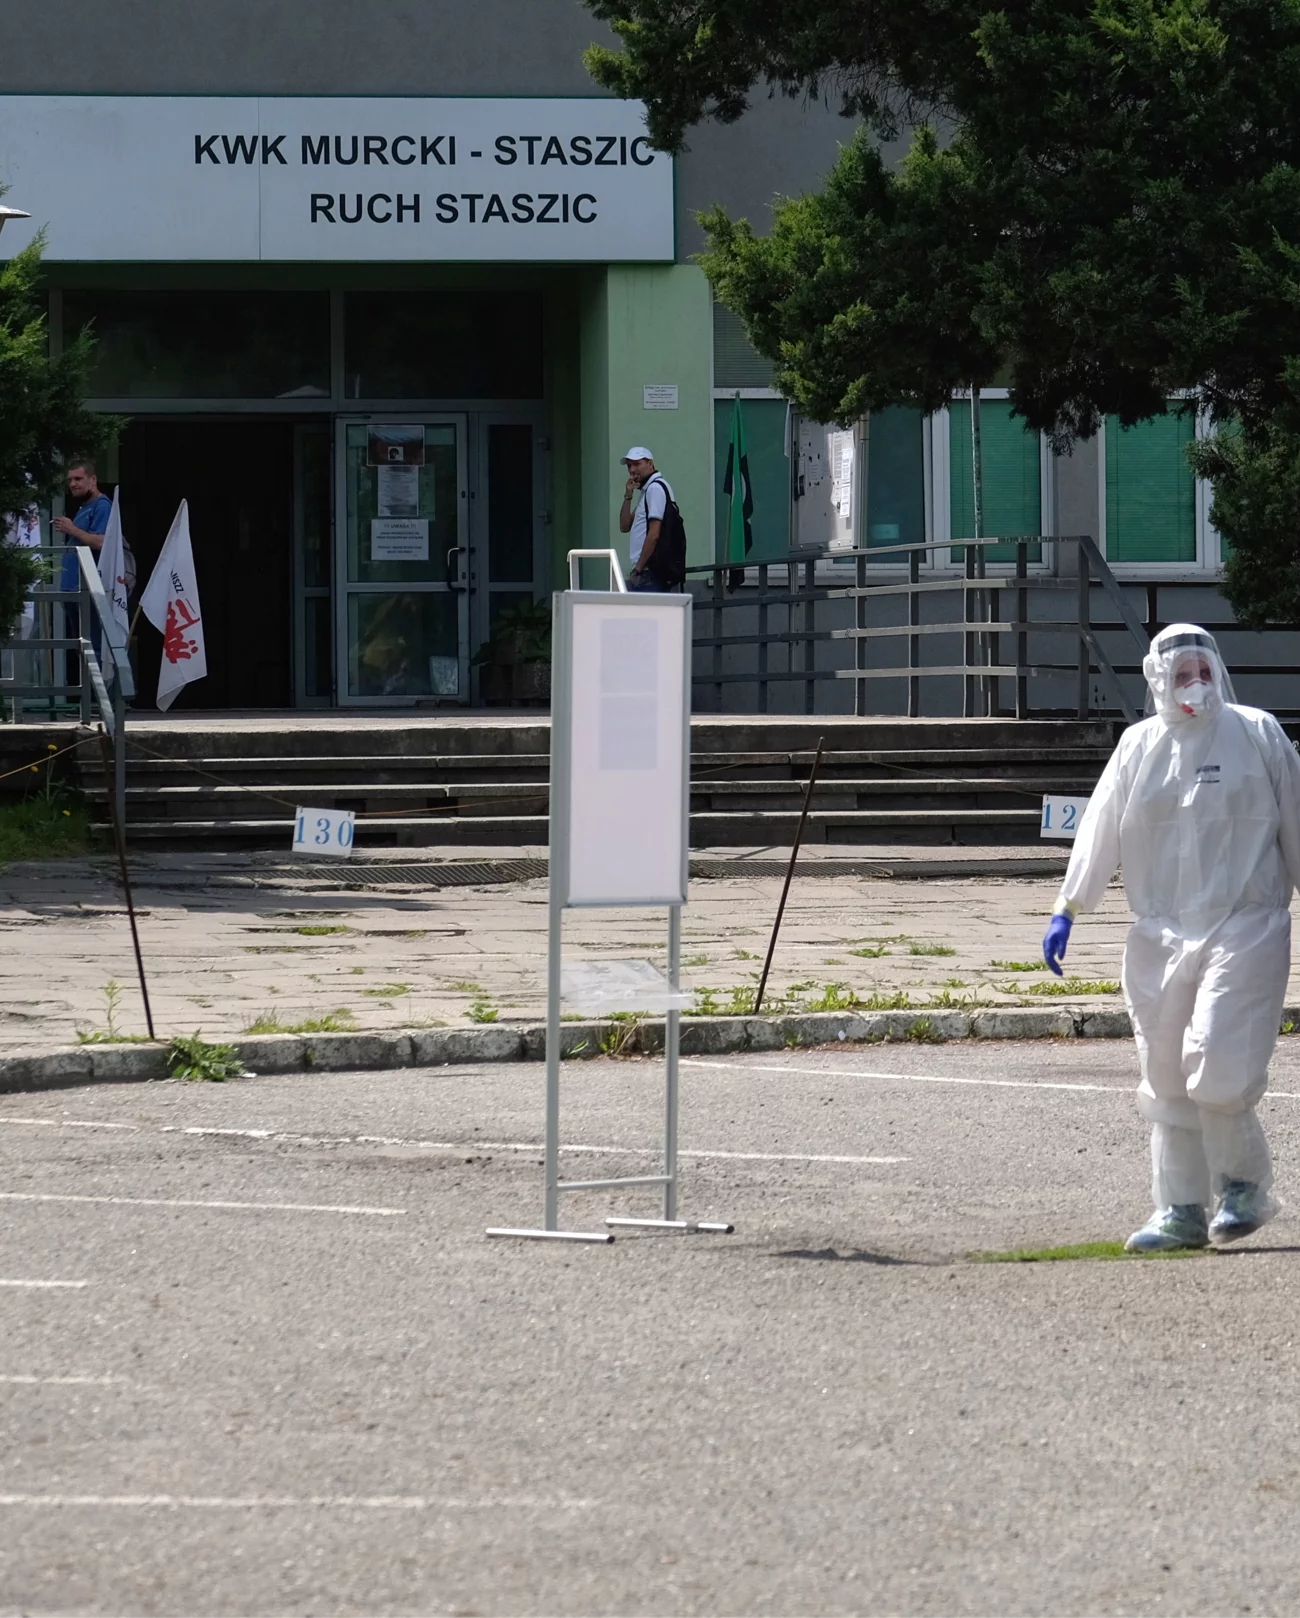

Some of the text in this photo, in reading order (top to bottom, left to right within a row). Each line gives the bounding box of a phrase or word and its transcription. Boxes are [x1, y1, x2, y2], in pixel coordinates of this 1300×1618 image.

[194, 135, 288, 165] KWK
[301, 135, 456, 166] MURCKI
[494, 135, 655, 166] STASZIC
[310, 193, 598, 224] RUCH STASZIC
[294, 816, 353, 847] 130
[1042, 803, 1086, 830] 12
